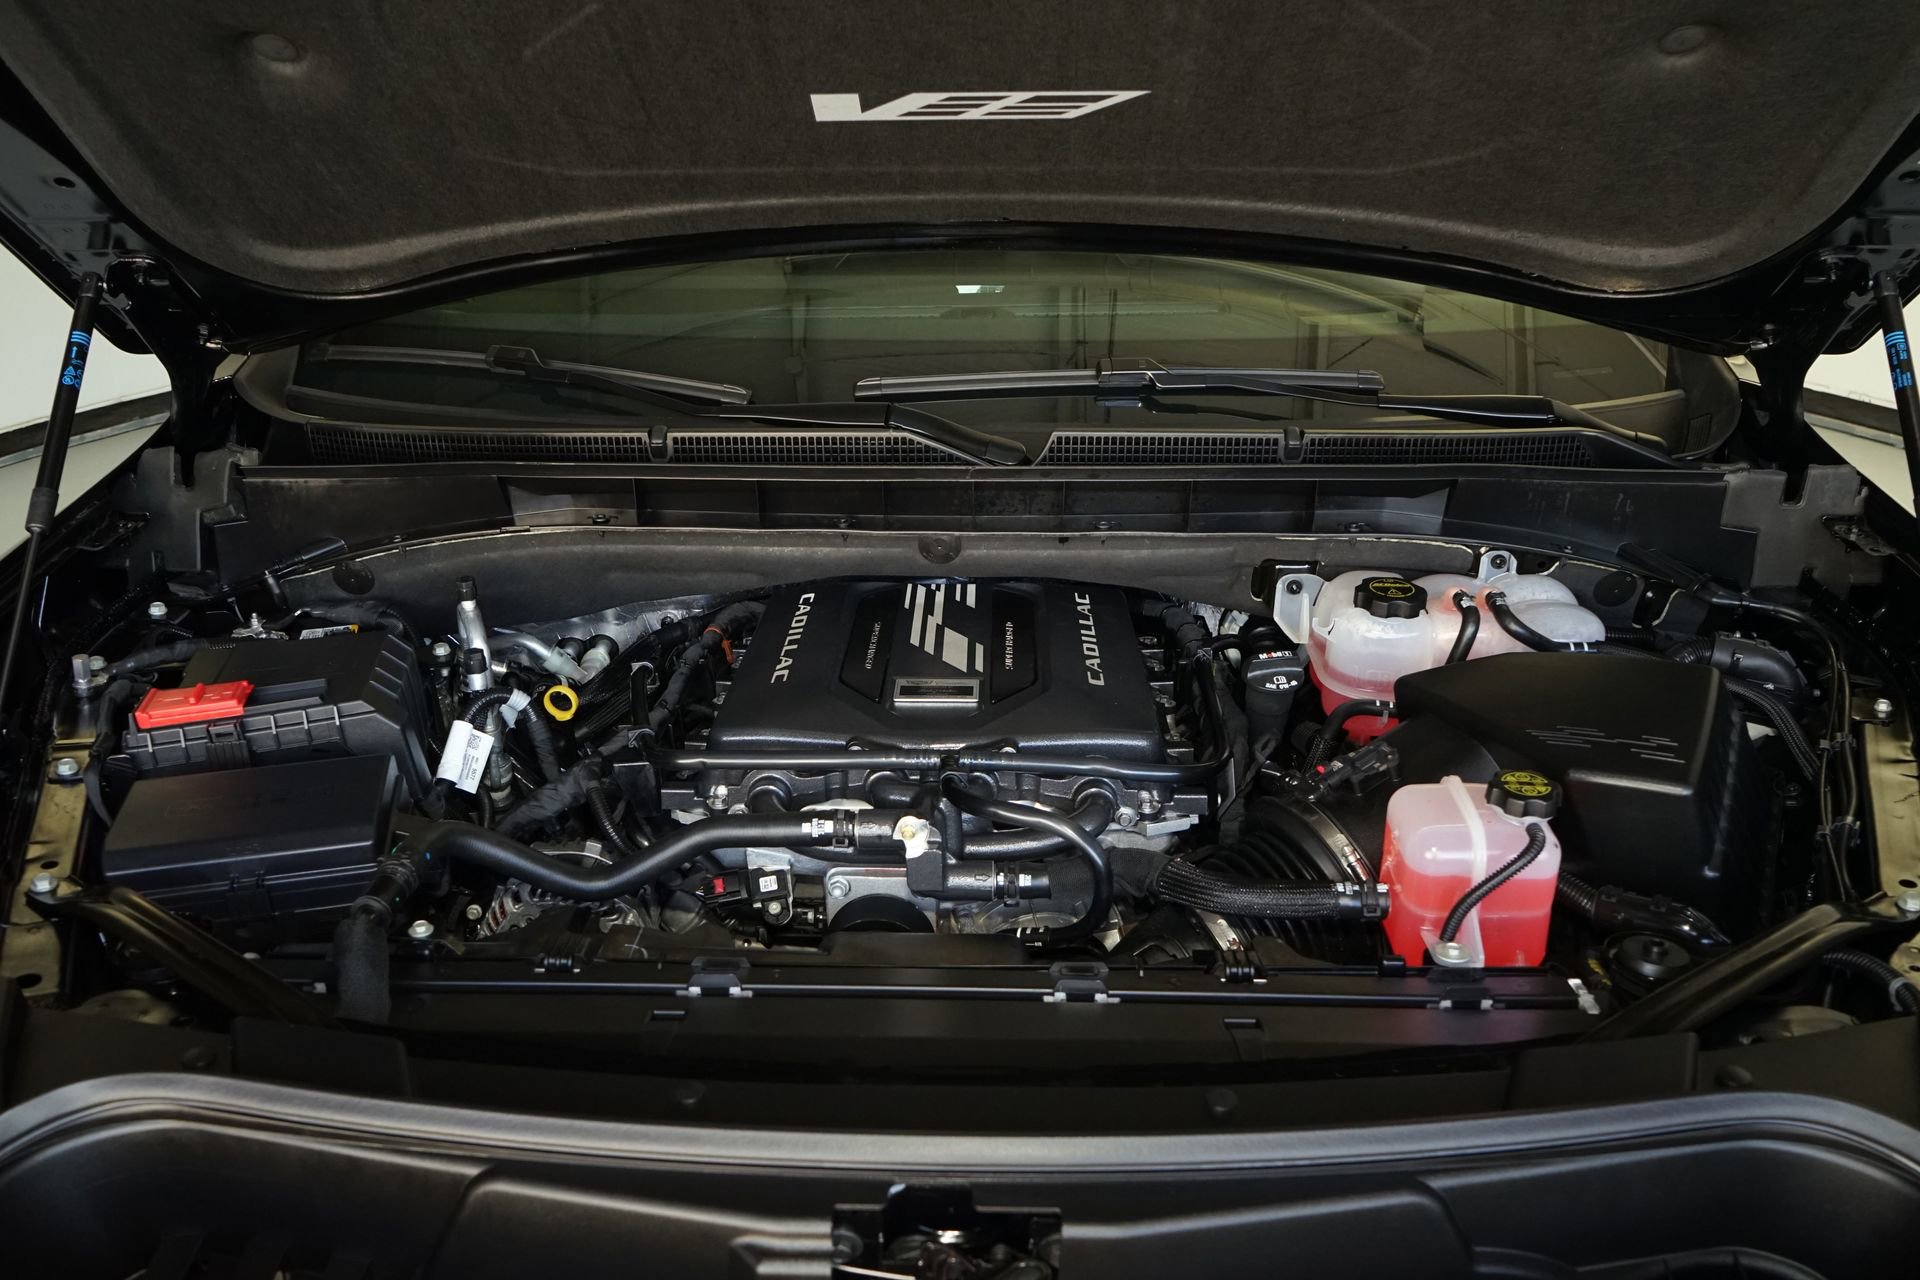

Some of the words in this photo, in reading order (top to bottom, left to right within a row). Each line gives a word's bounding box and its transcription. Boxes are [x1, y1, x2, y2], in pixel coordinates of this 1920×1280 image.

[770, 593, 815, 684] CADILLAC
[1075, 592, 1104, 685] CADILLAC
[1259, 651, 1282, 659] Mobil
